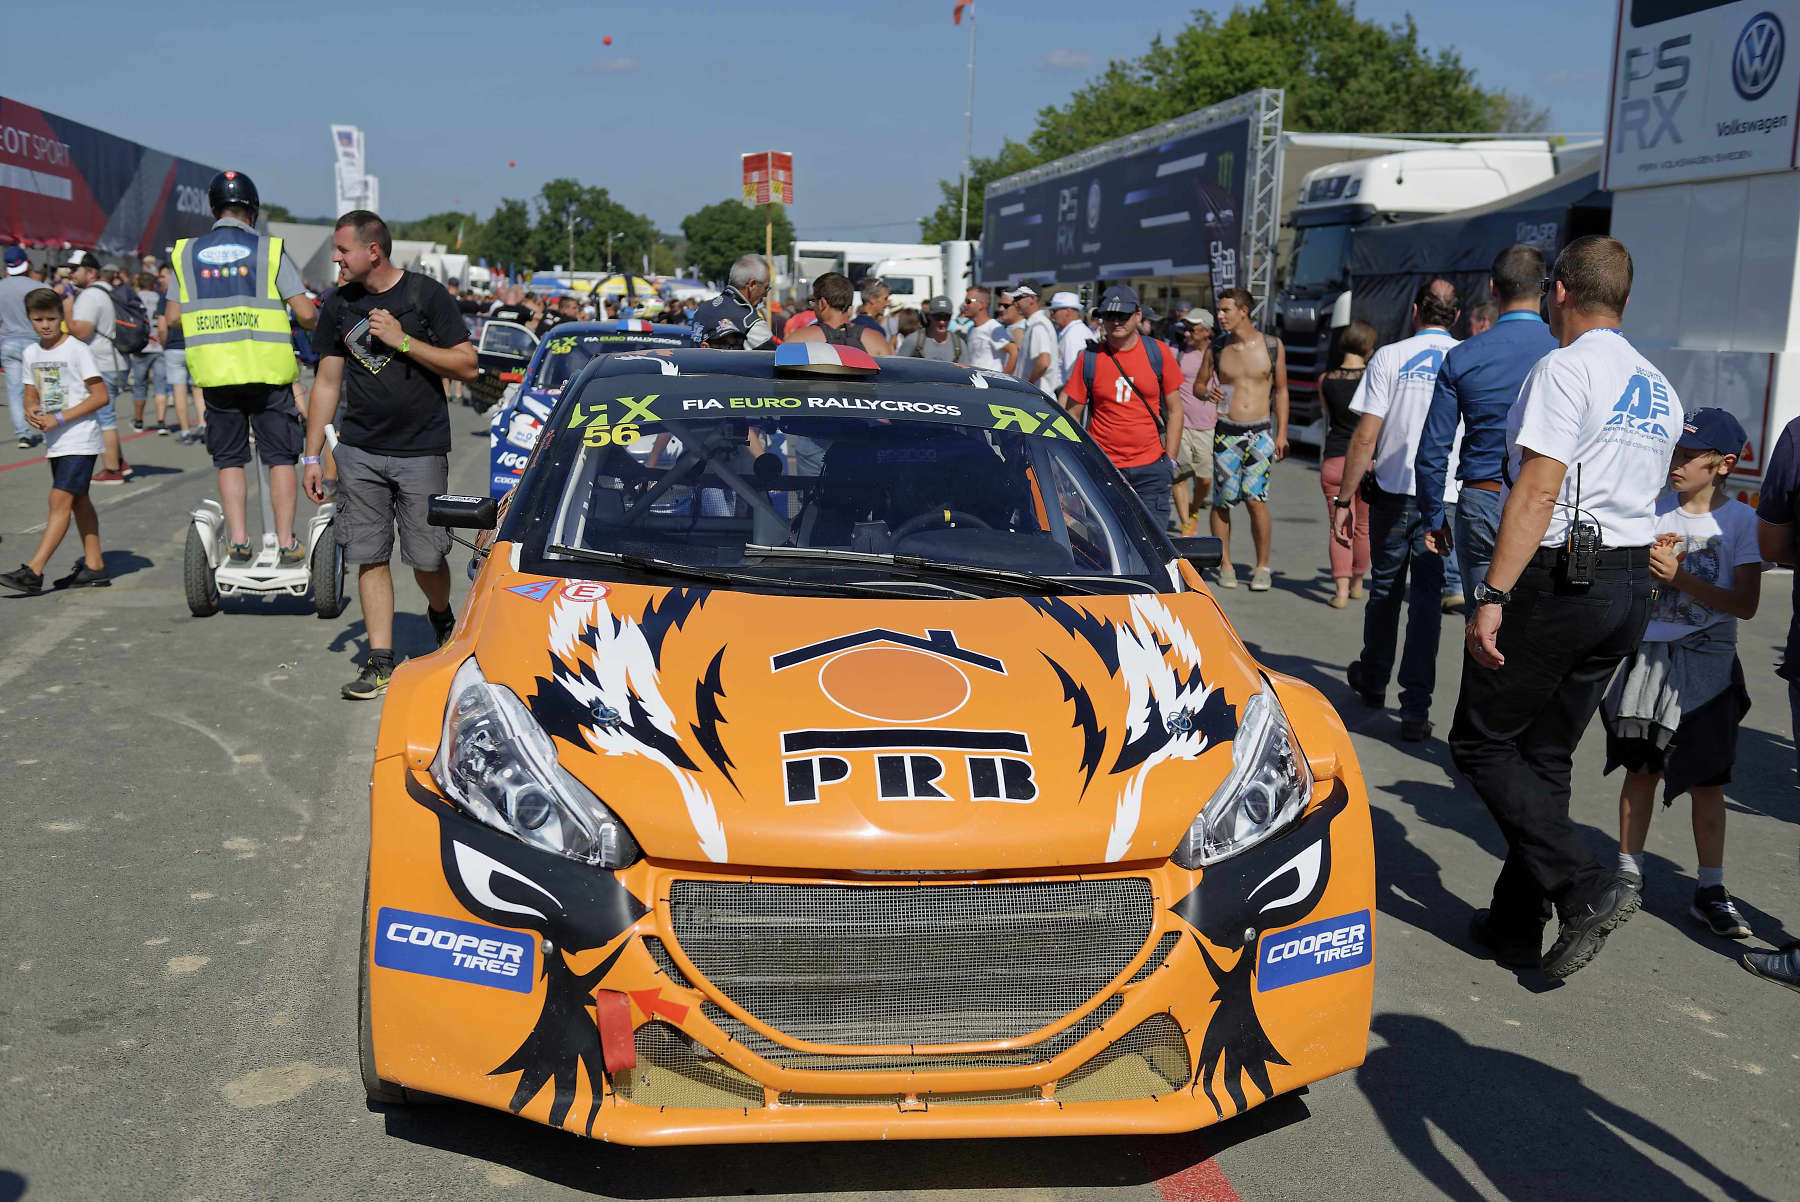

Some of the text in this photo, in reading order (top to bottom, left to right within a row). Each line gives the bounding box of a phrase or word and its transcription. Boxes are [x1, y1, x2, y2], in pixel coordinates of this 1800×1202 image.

[1616, 90, 1687, 154] RX
[1717, 114, 1788, 138] Volkswagen
[32, 134, 70, 168] SPORT
[627, 336, 683, 346] RALLYCROSS
[683, 398, 962, 416] FIA EURO RALLYCROSS
[582, 424, 641, 447] 56
[782, 754, 1039, 806] PRB
[386, 923, 524, 964] COOPER
[1266, 924, 1365, 964] COOPER
[1314, 941, 1364, 965] TIRES
[451, 952, 521, 977] TIRES
